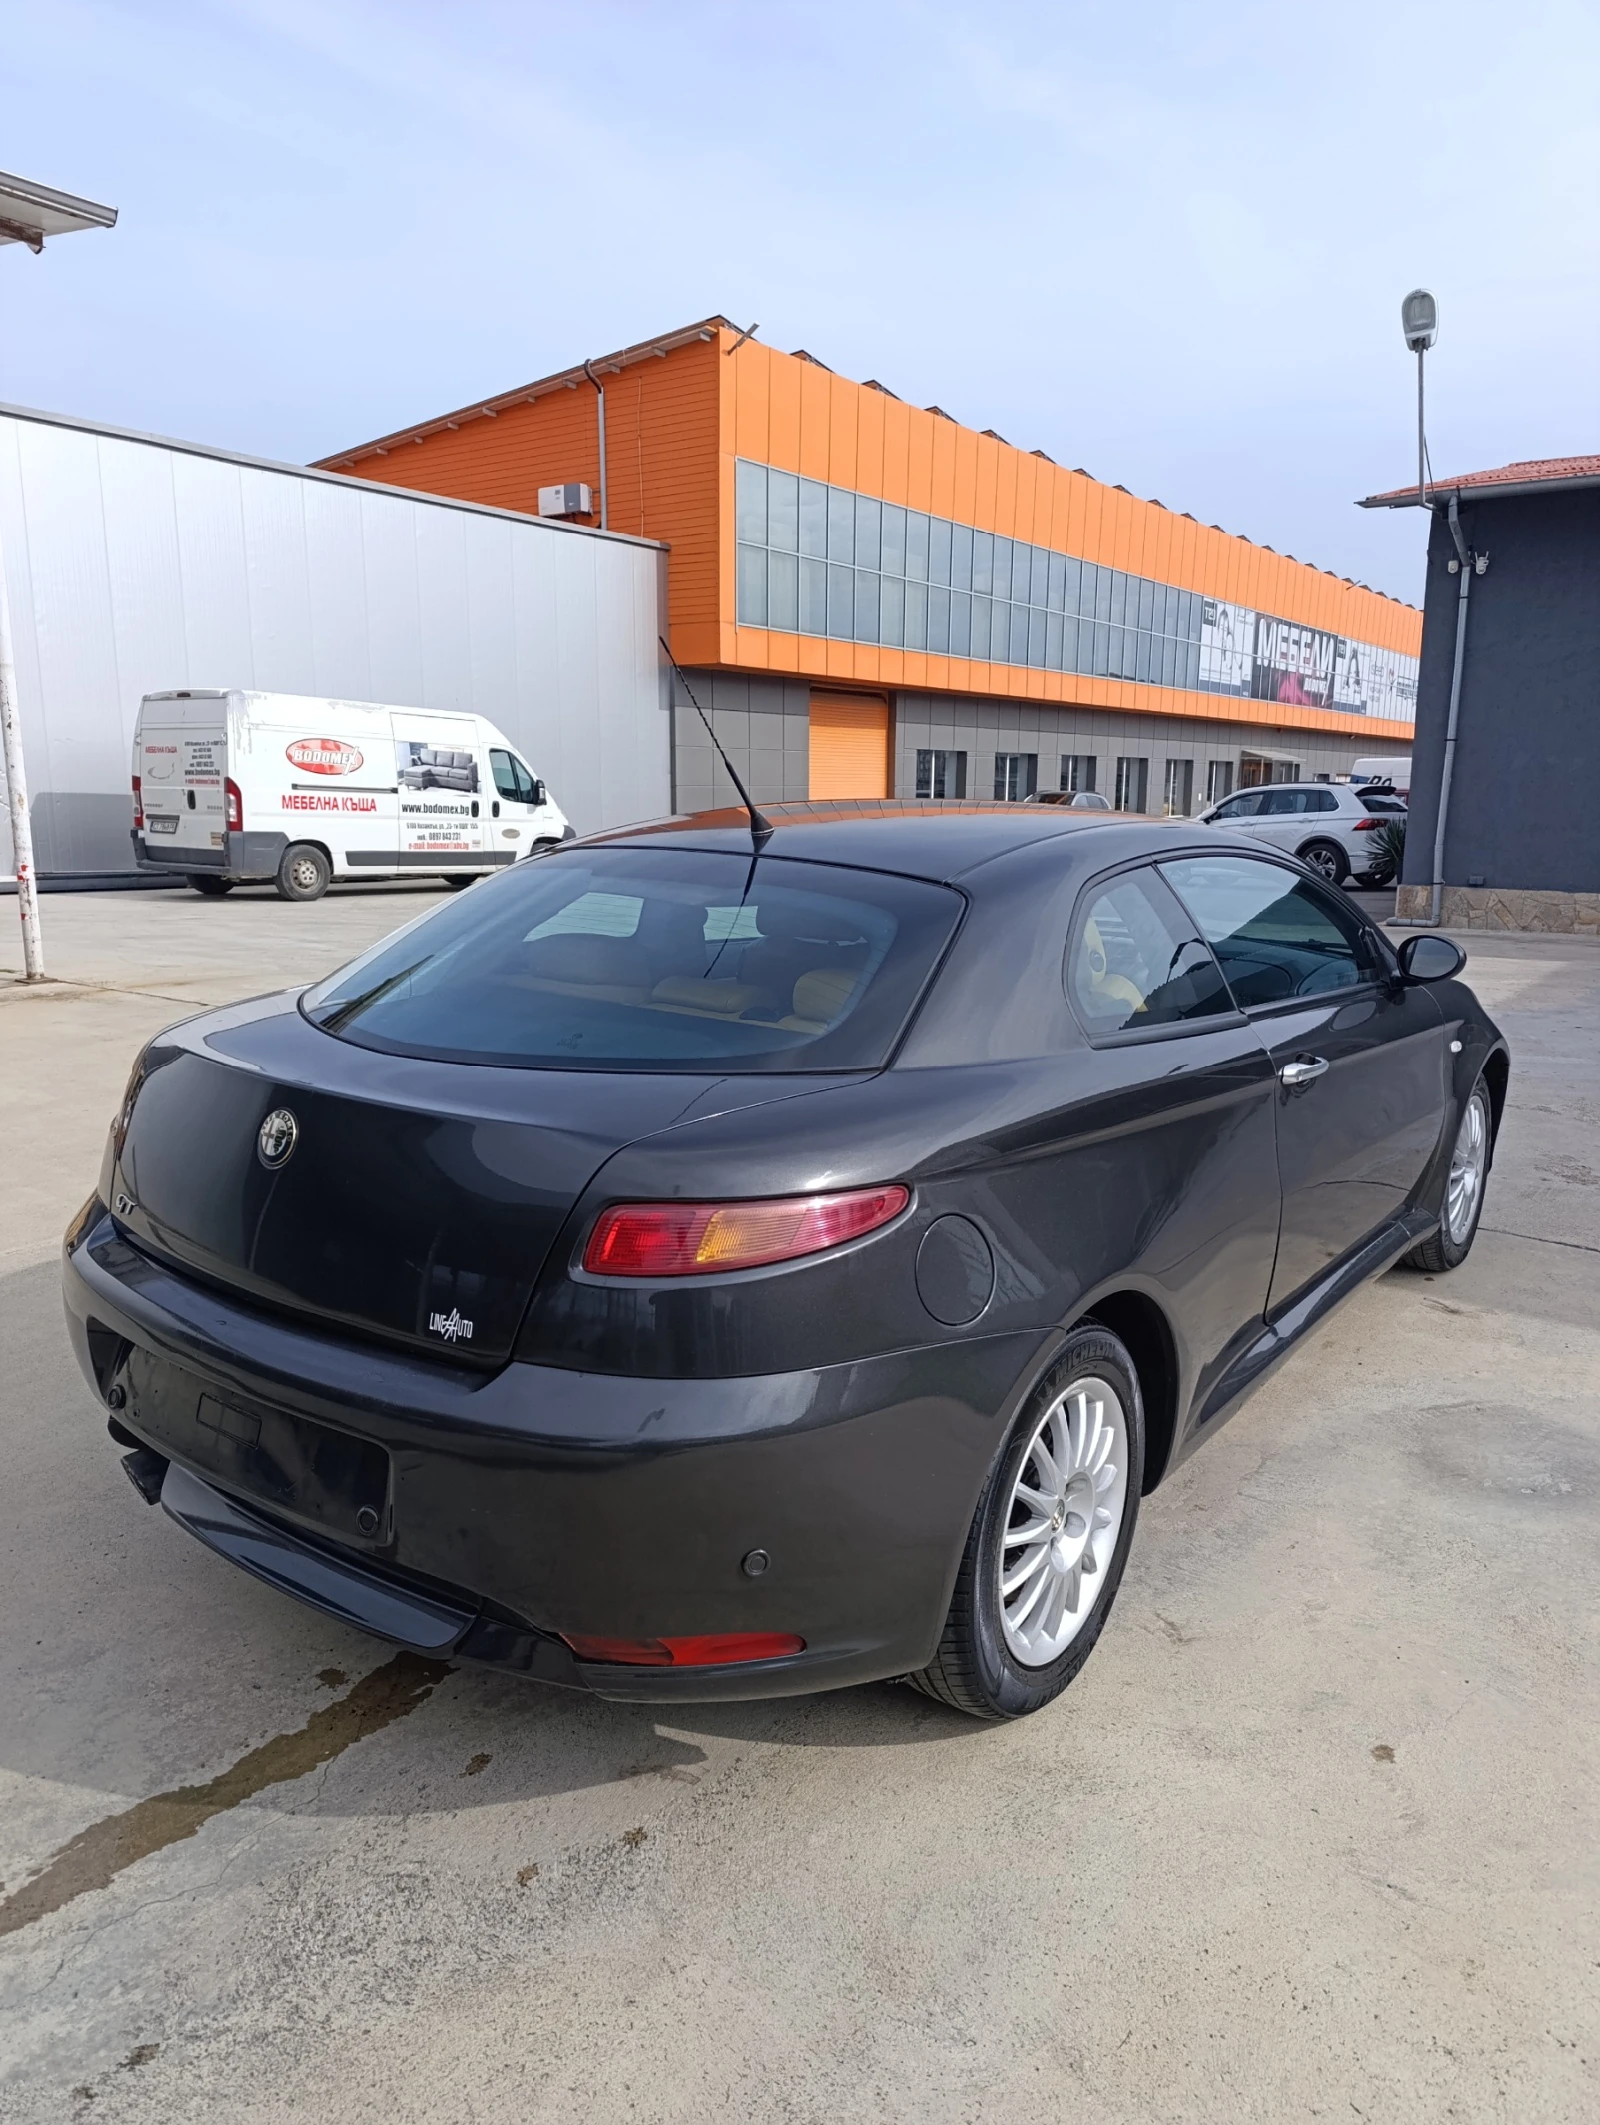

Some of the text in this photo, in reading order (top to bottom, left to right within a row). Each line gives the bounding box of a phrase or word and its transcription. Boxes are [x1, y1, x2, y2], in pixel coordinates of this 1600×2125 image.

[293, 746, 360, 776] BODOMEX
[281, 794, 340, 811] МЕБЕЛНА
[401, 803, 470, 816] www.bodomex.bg
[1055, 1341, 1115, 1384] MICHELIN
